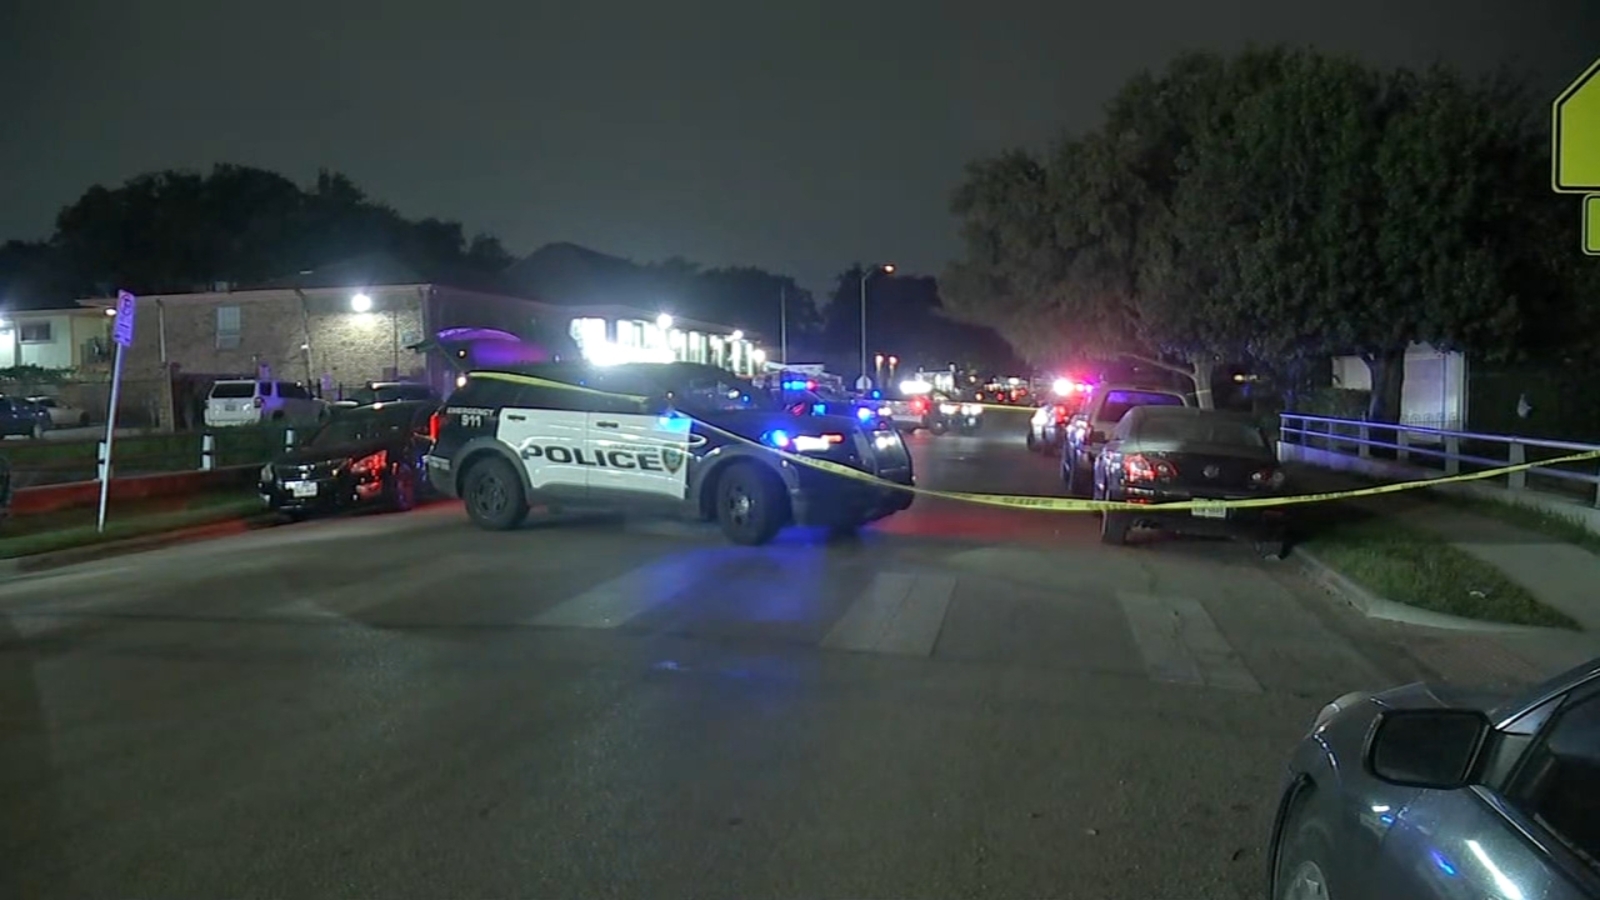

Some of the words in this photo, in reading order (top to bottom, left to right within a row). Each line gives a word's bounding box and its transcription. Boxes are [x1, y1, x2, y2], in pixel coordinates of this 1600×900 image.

[446, 407, 495, 417] EMERGENCY
[461, 414, 481, 427] 911
[521, 444, 664, 472] POLICE
